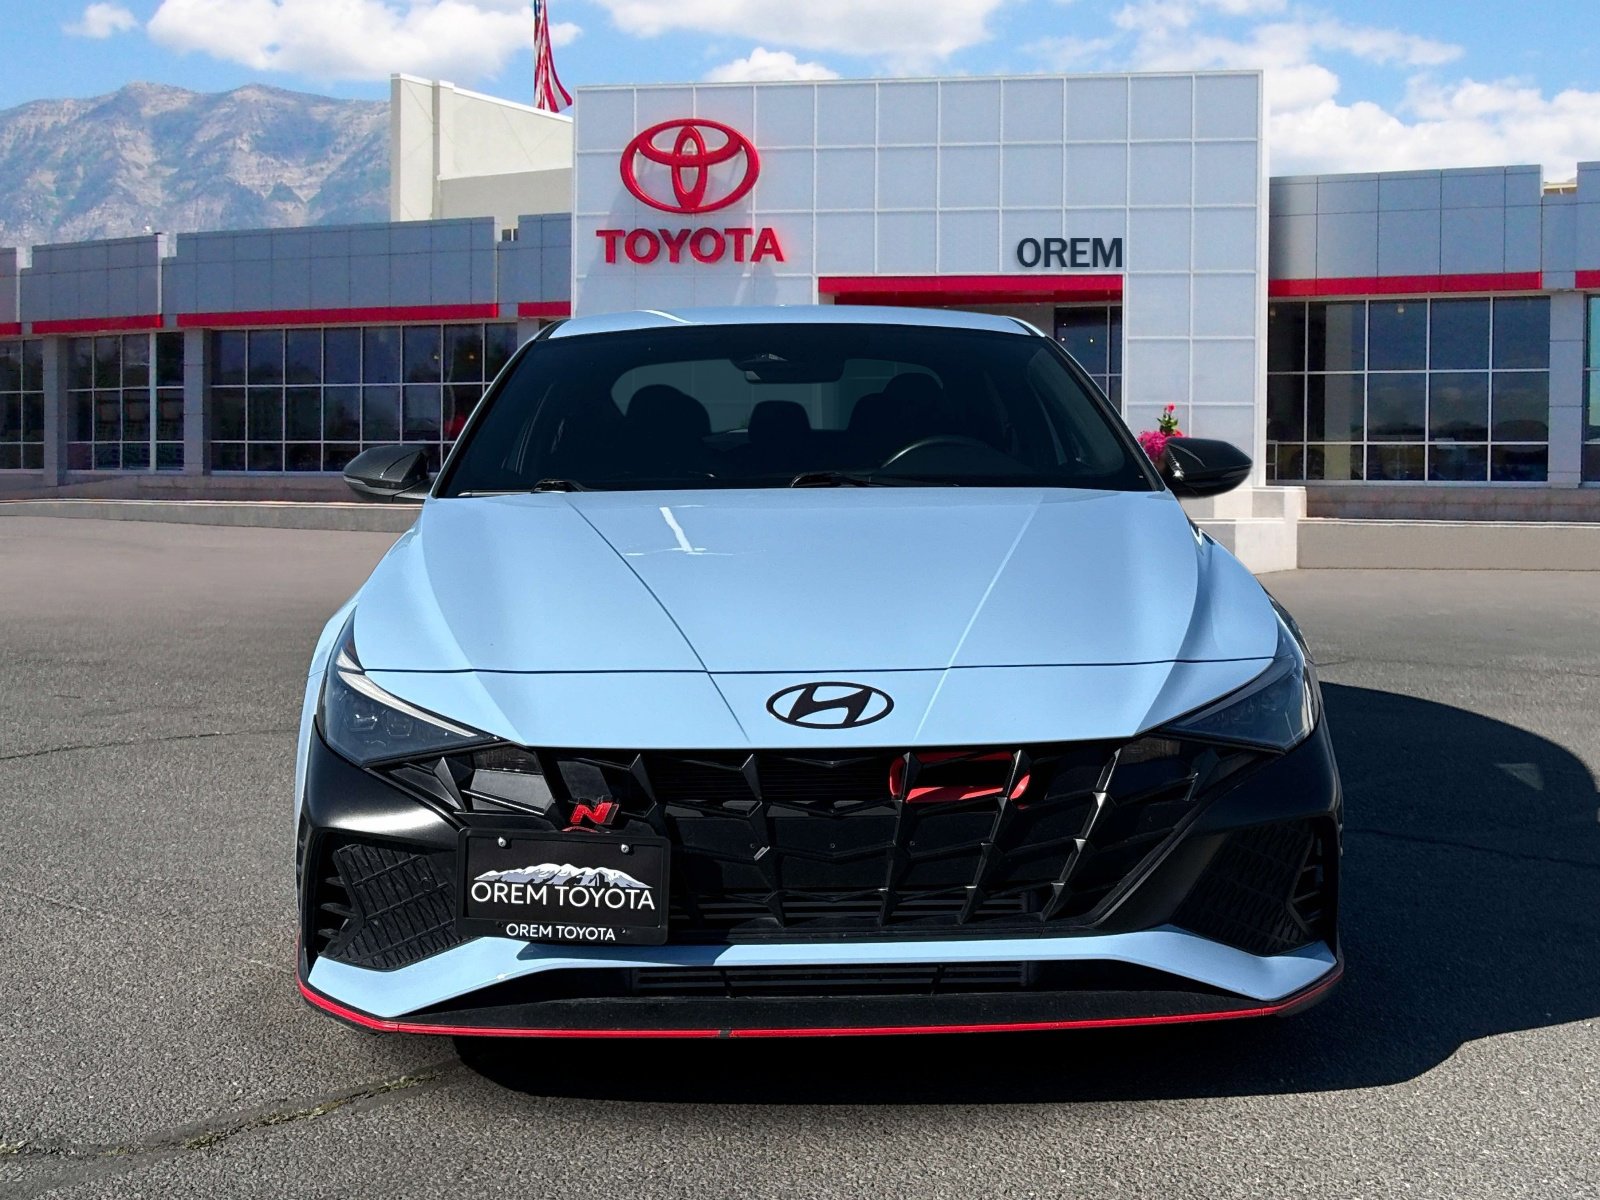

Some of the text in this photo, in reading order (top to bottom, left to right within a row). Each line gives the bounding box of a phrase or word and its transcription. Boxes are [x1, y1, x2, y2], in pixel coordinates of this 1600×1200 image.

[596, 227, 785, 264] TOYOTA
[1016, 237, 1123, 268] OREM
[471, 881, 656, 910] OREM TOYOTA
[506, 923, 616, 941] OREM TOYOTA
